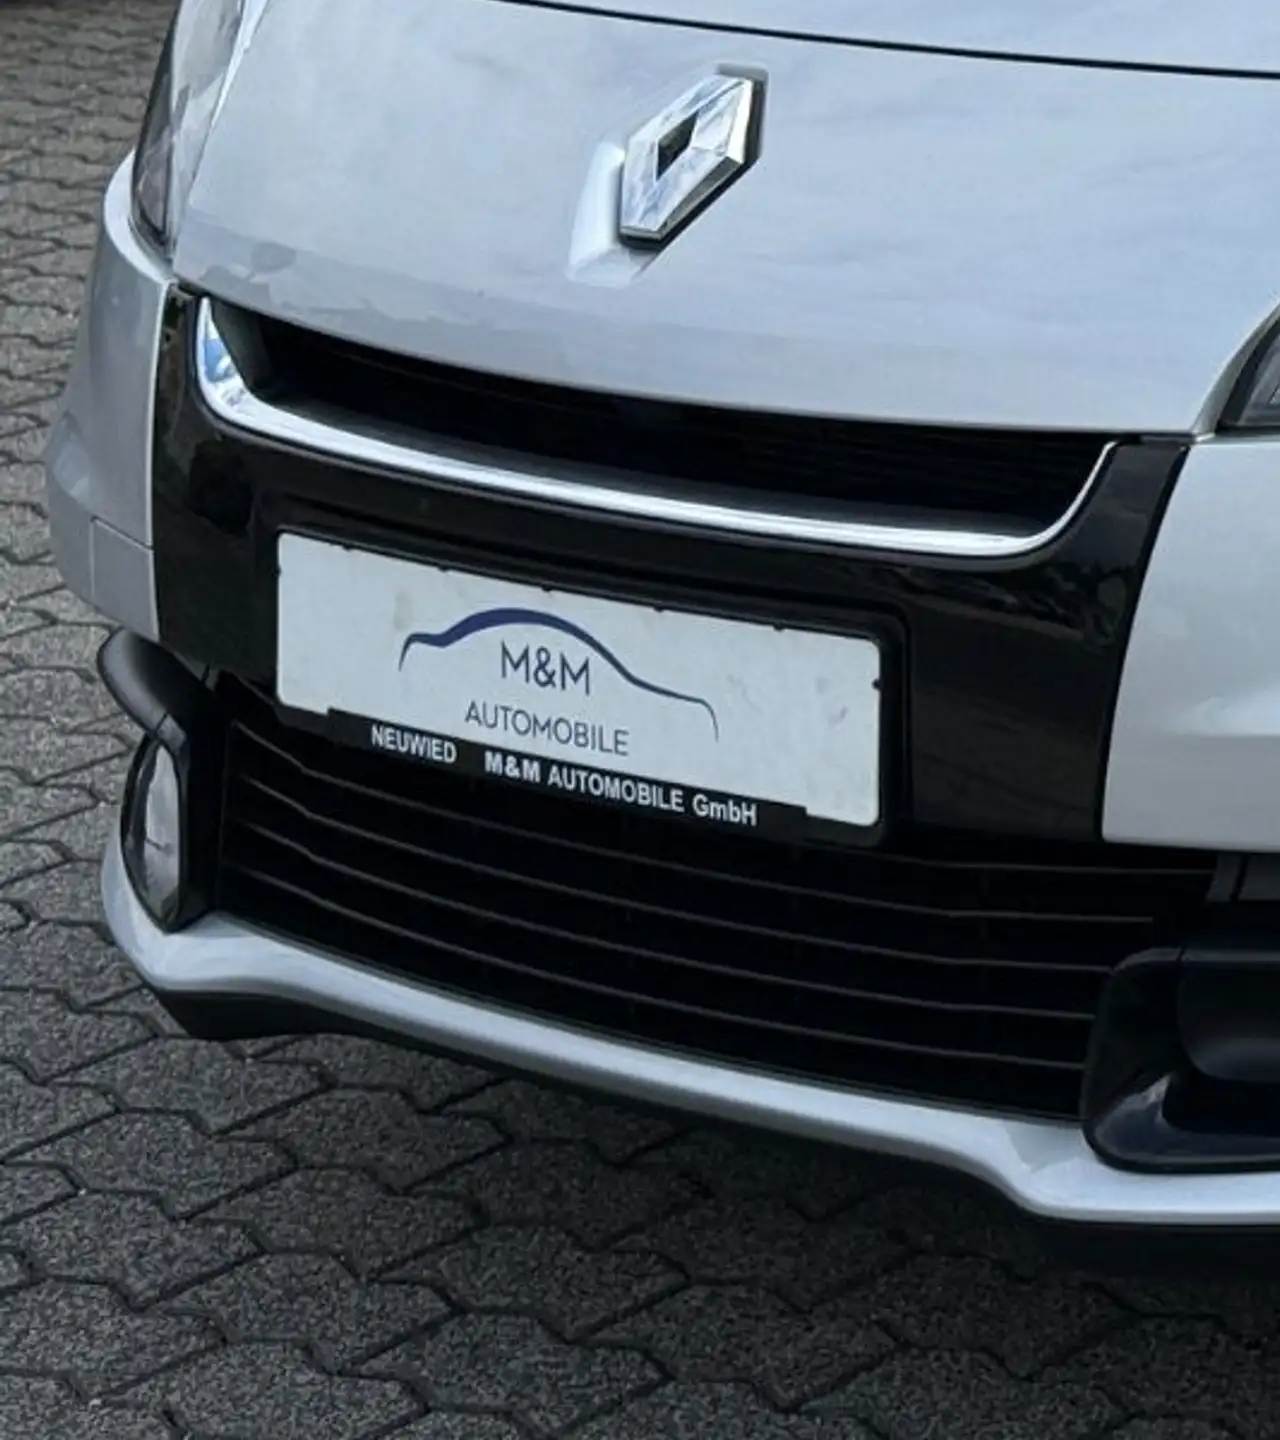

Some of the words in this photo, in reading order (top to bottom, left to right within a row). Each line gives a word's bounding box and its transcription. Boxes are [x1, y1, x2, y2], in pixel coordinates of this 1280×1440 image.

[500, 639, 591, 697] M&M
[464, 698, 630, 757] AUTOMOBILE
[371, 723, 458, 765] NEUWIED
[484, 749, 541, 785] M&M
[547, 763, 686, 814] AUTOMOBILE
[692, 792, 758, 827] GmbH
